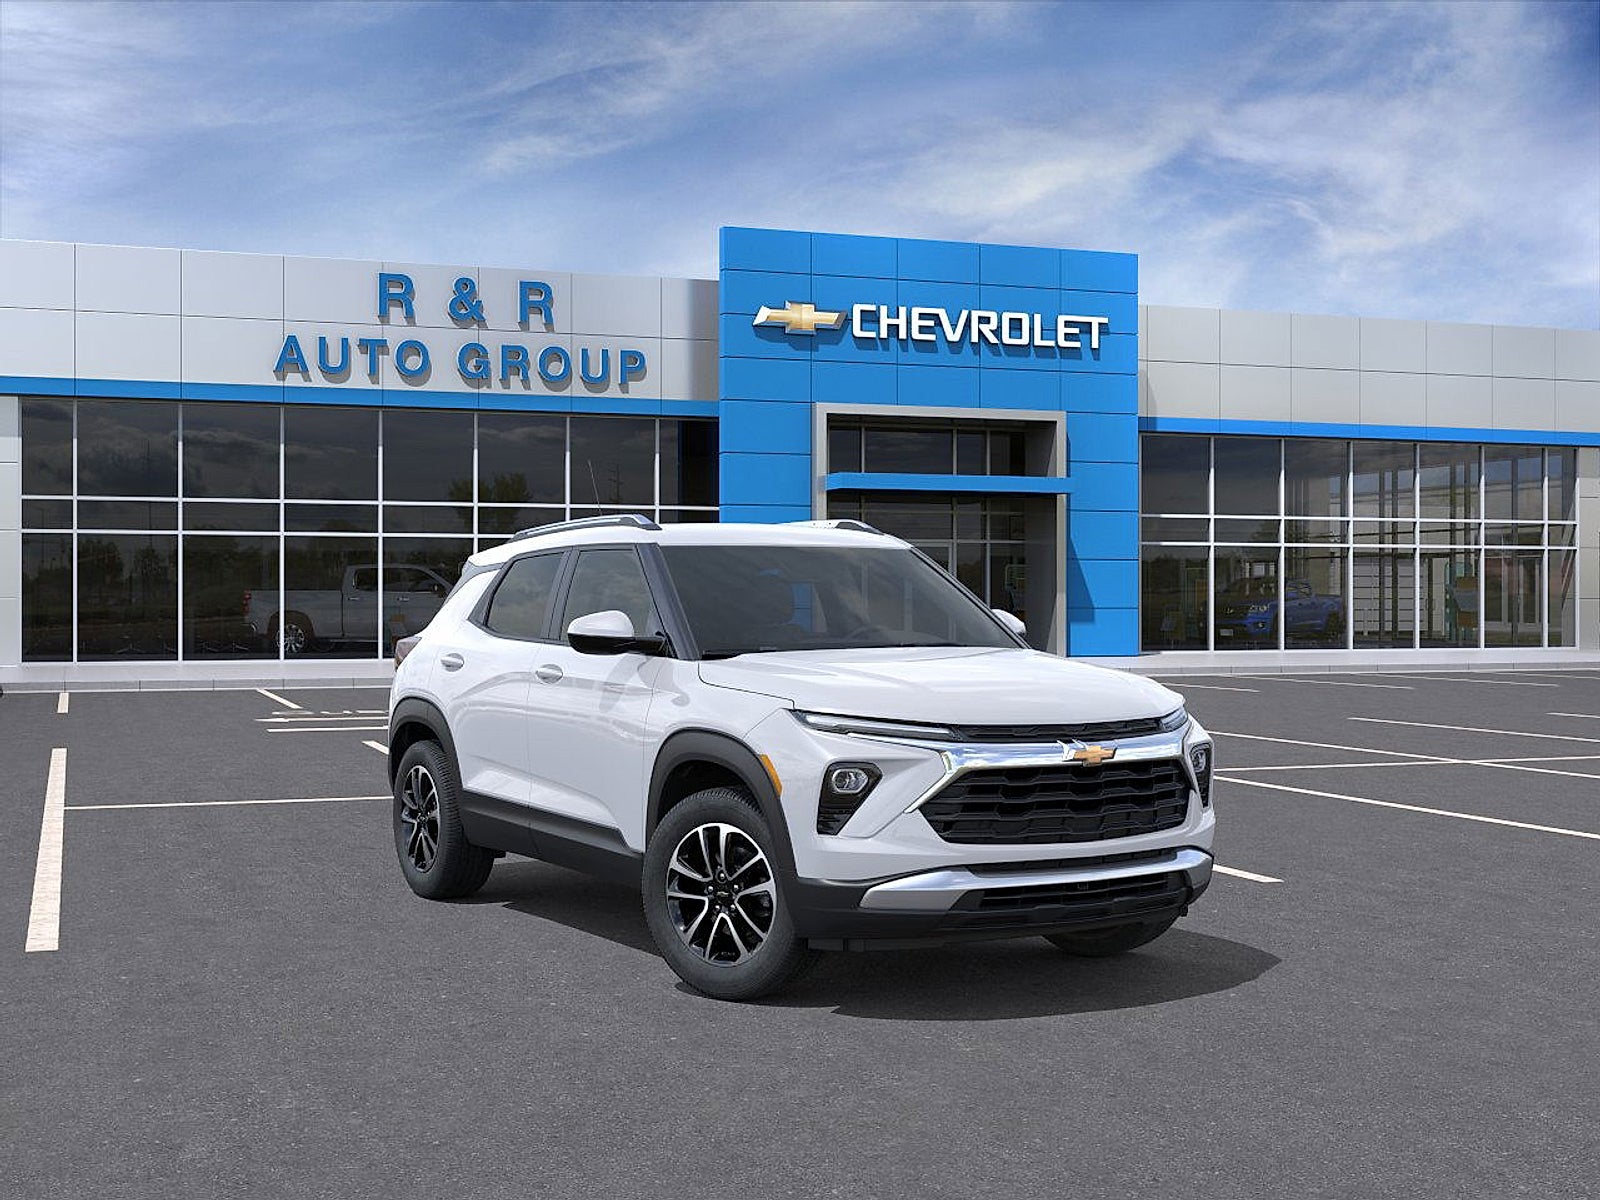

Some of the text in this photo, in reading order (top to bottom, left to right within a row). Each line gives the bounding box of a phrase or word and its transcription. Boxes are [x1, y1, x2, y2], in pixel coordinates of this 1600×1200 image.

[377, 272, 554, 326] R & R
[851, 303, 1109, 349] CHEVROLET
[274, 334, 646, 385] AUTO GROUP
